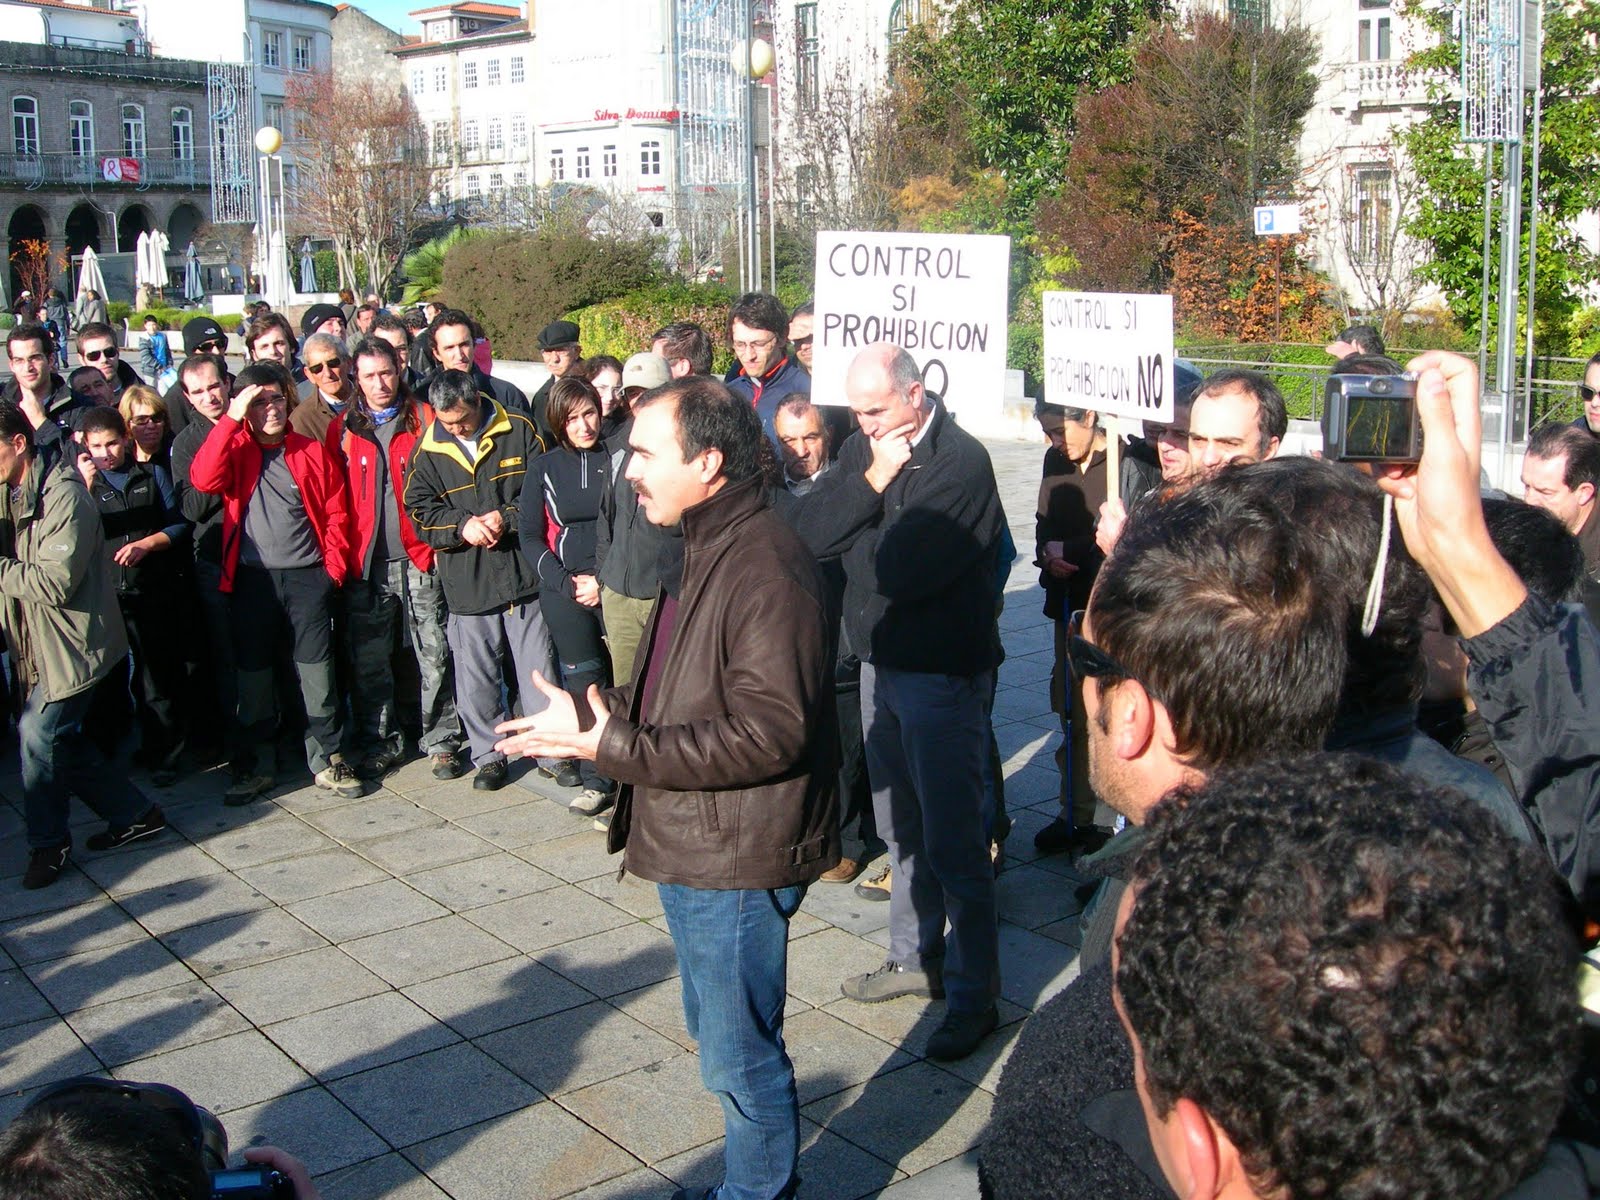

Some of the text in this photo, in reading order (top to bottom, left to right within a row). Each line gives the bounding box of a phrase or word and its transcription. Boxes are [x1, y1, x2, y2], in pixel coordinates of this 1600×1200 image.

[594, 109, 619, 121] Silva
[1260, 212, 1272, 231] P
[829, 243, 970, 279] CONTROL
[892, 284, 916, 312] SI
[1049, 297, 1137, 330] CONTROL SI
[824, 313, 989, 353] PROHIBICION
[1050, 353, 1163, 409] PROHIBICION NO
